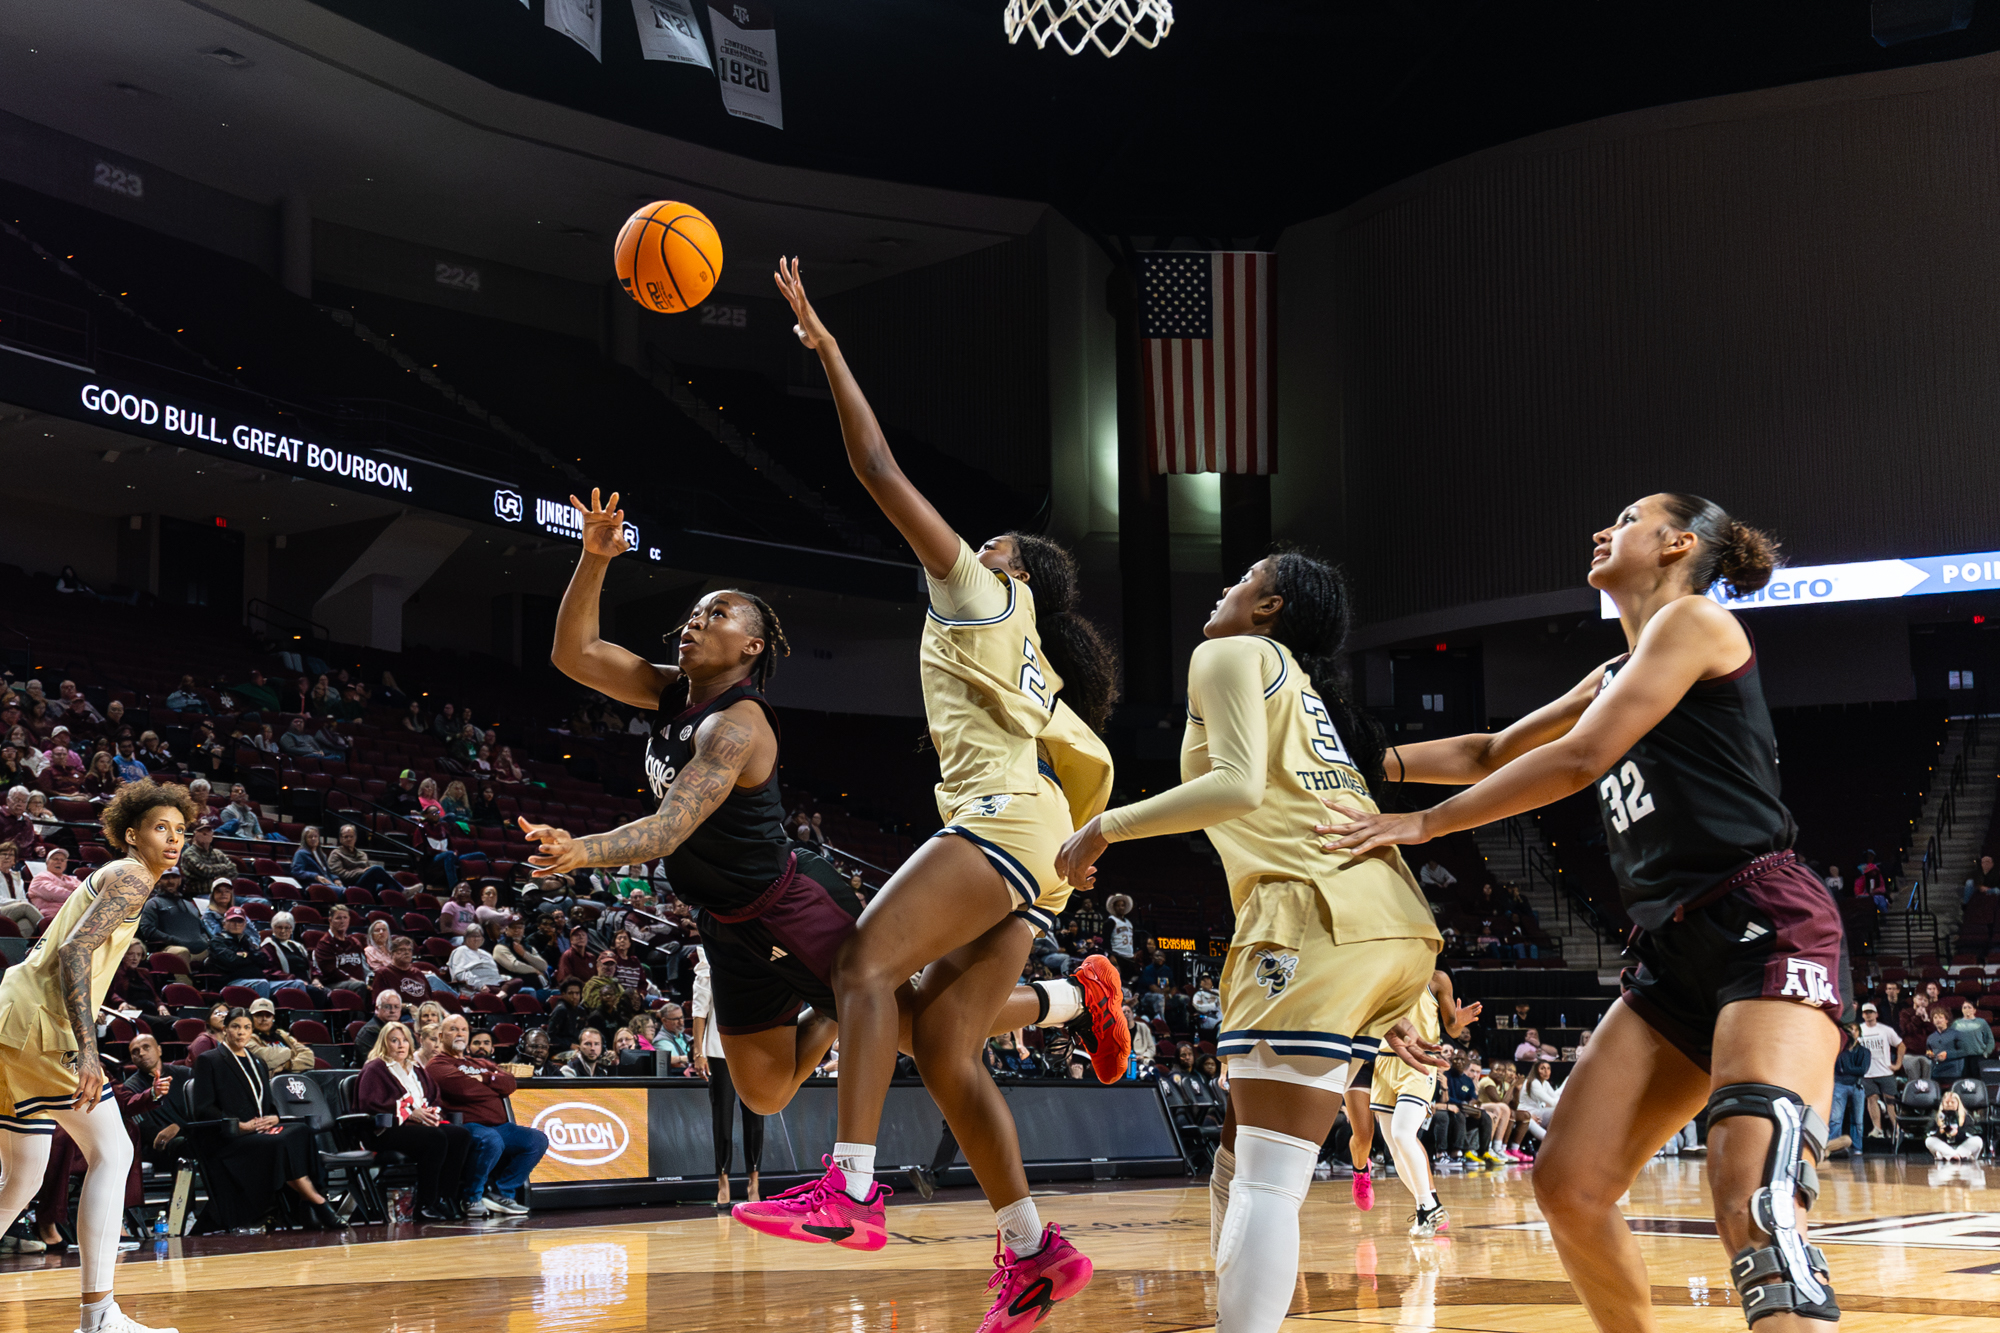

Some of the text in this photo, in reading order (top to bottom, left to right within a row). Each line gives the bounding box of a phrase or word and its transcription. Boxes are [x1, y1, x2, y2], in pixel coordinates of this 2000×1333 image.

[719, 57, 770, 93] 1920
[94, 163, 142, 197] 223
[435, 263, 480, 291] 224
[701, 305, 747, 327] 225
[81, 384, 413, 492] GOOD BULL. GREAT BOURBON.
[650, 547, 661, 560] CC
[1600, 760, 1655, 833] 32
[544, 1117, 619, 1152] COTTON
